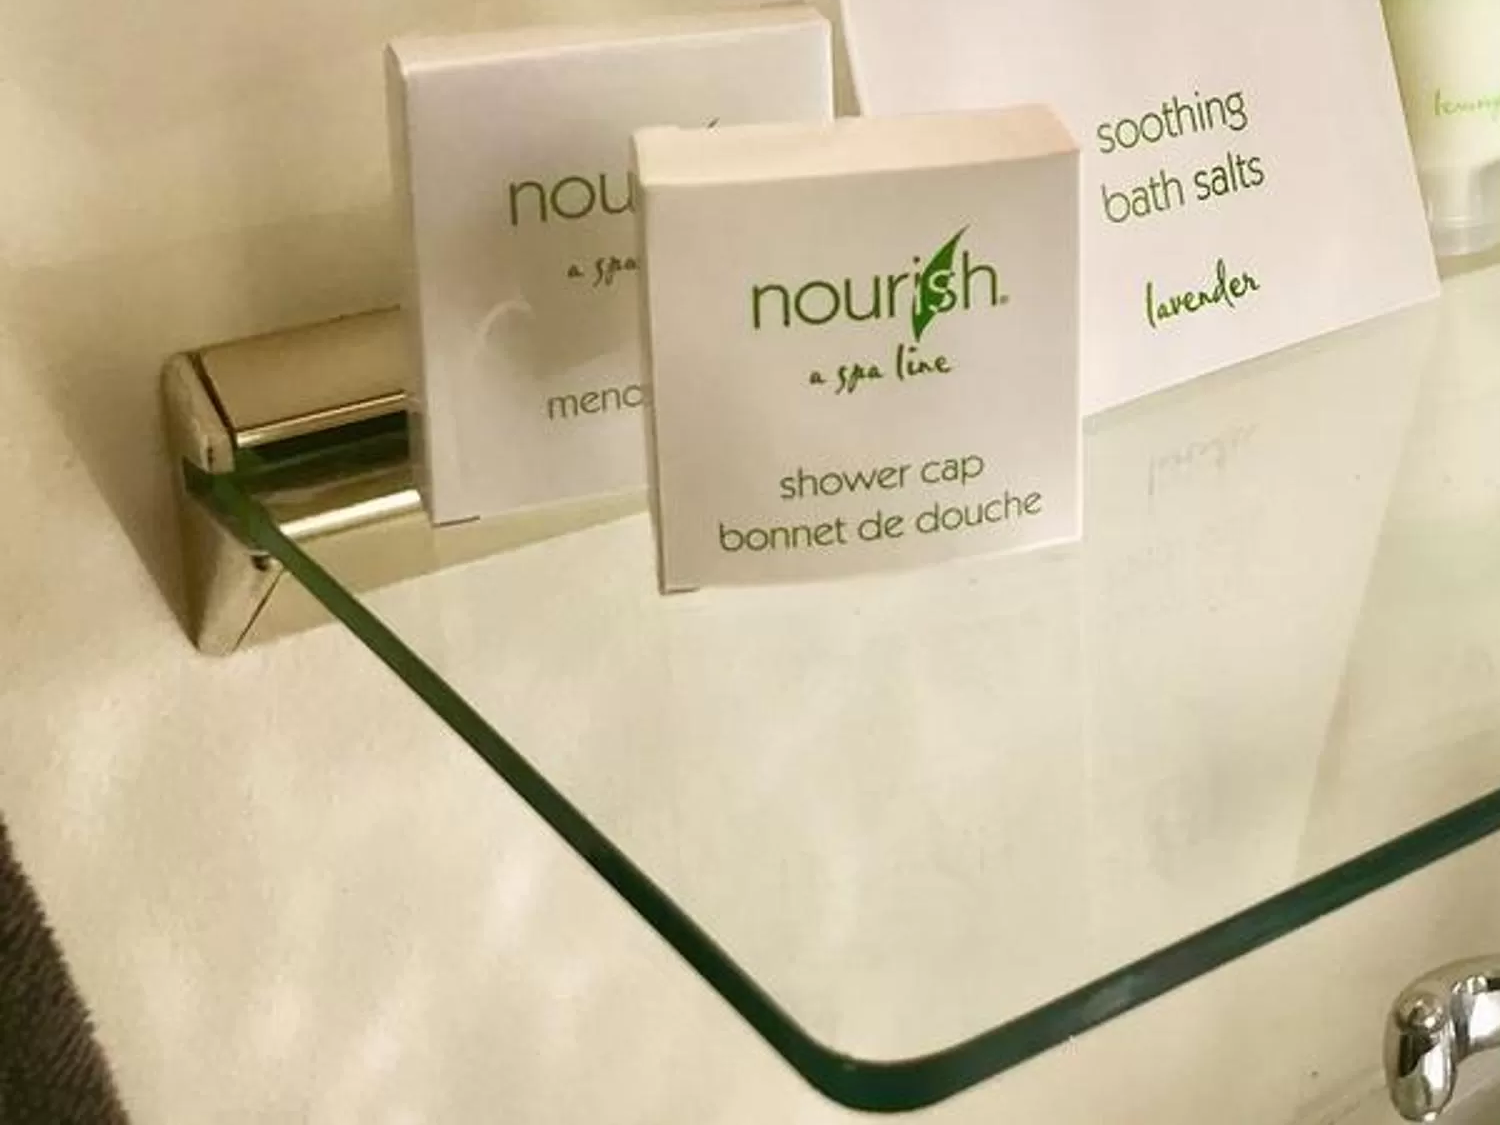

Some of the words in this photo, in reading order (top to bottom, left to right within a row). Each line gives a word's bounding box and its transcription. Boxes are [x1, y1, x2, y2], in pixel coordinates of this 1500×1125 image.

[1096, 90, 1249, 154] soothing
[1101, 169, 1185, 223] bath
[1194, 150, 1265, 201] salts
[566, 262, 585, 279] a
[592, 254, 640, 288] spa
[752, 238, 998, 333] nourish
[1146, 257, 1261, 329] lavender
[808, 371, 827, 385] a
[833, 363, 883, 396] spa
[896, 343, 953, 381] line
[779, 464, 912, 500] shower
[919, 454, 985, 488] cap
[718, 517, 848, 552] bonnet
[856, 509, 905, 542] de
[915, 489, 1043, 535] douche
